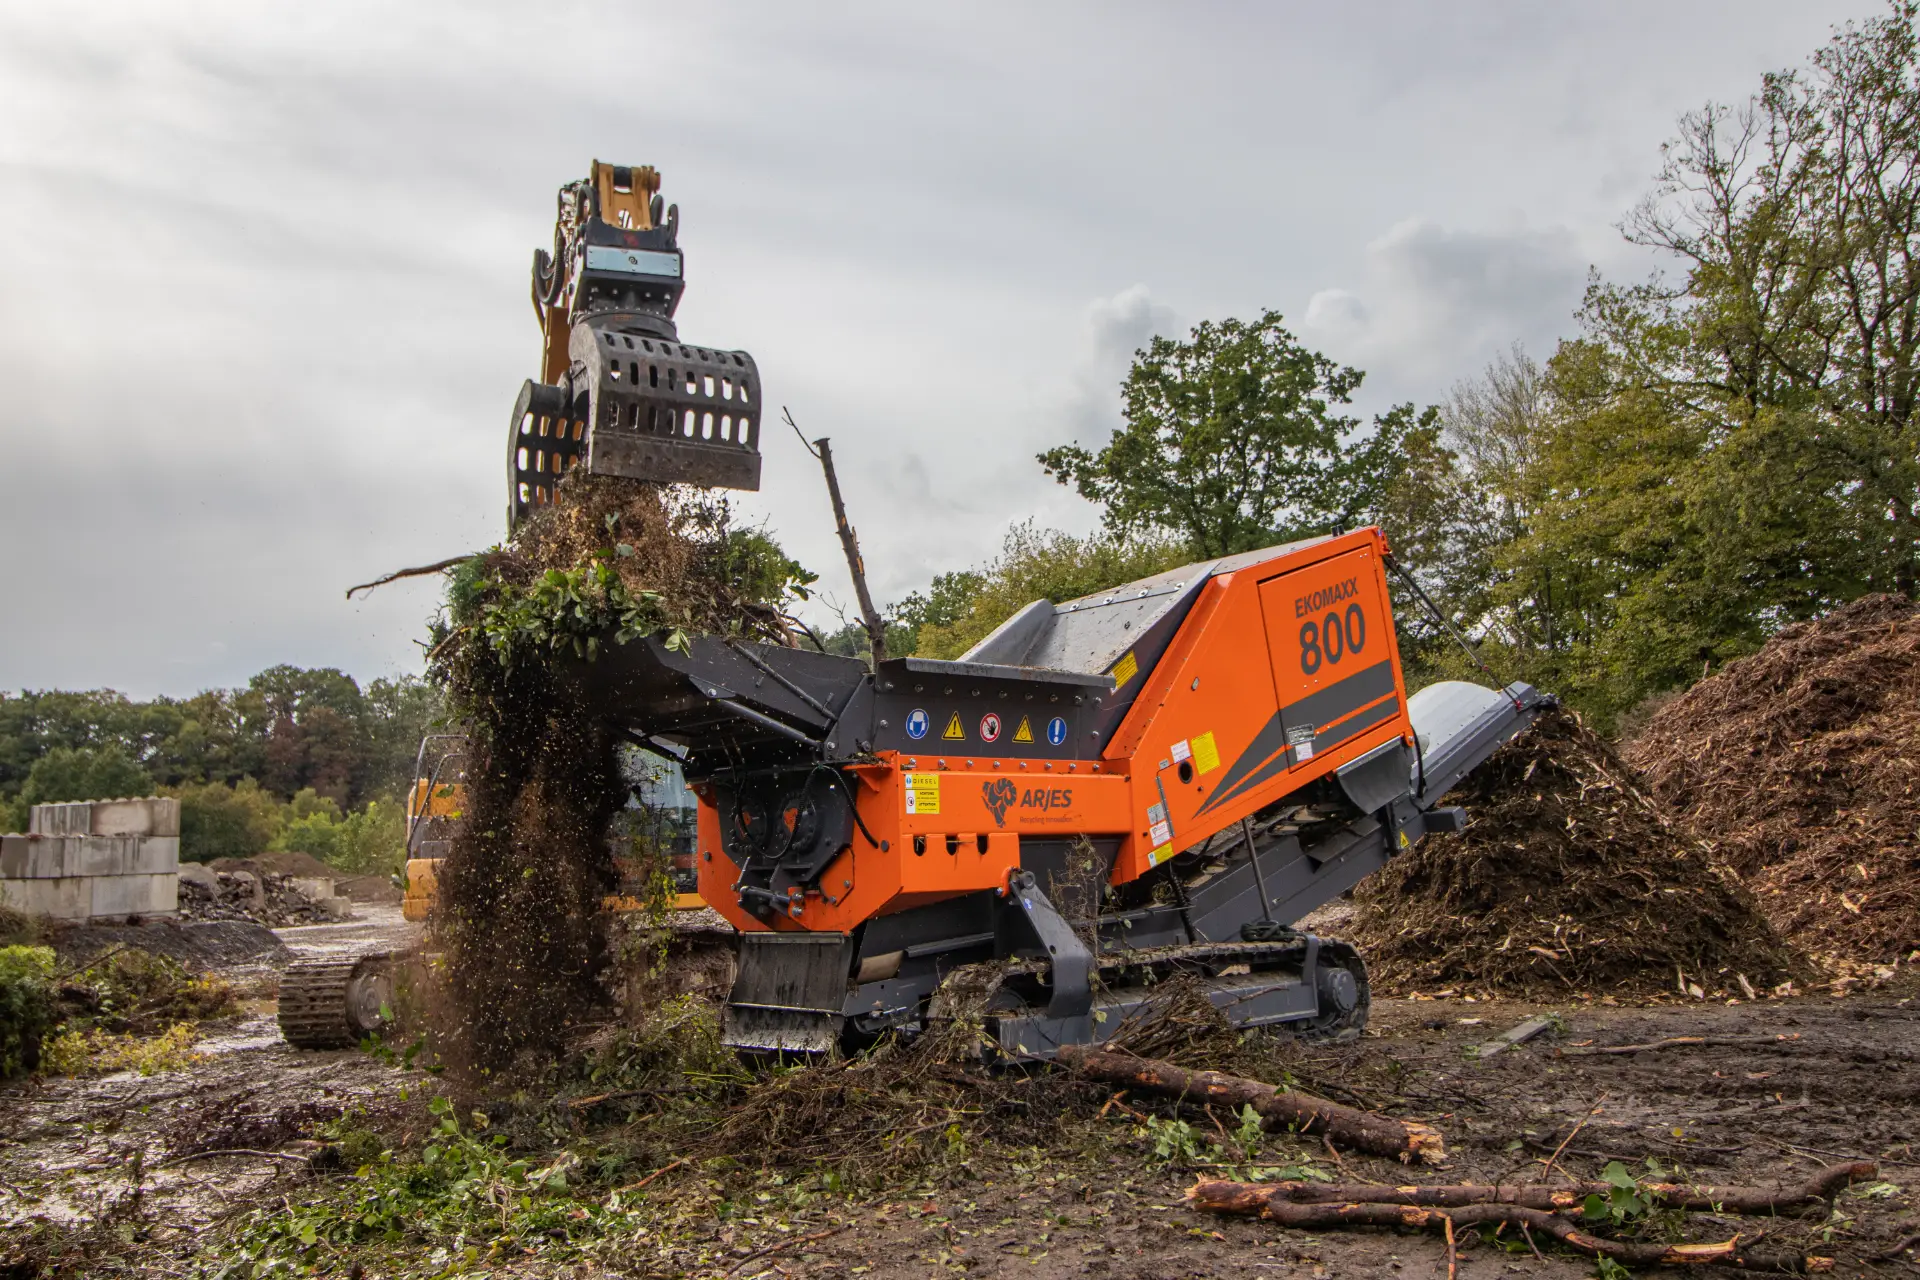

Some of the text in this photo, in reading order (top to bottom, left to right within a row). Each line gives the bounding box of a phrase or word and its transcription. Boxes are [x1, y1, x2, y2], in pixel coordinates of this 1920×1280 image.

[1295, 576, 1359, 619] EKOMAXX
[1299, 602, 1366, 676] 800
[1020, 784, 1073, 812] ARJES
[1020, 816, 1045, 824] Recycling
